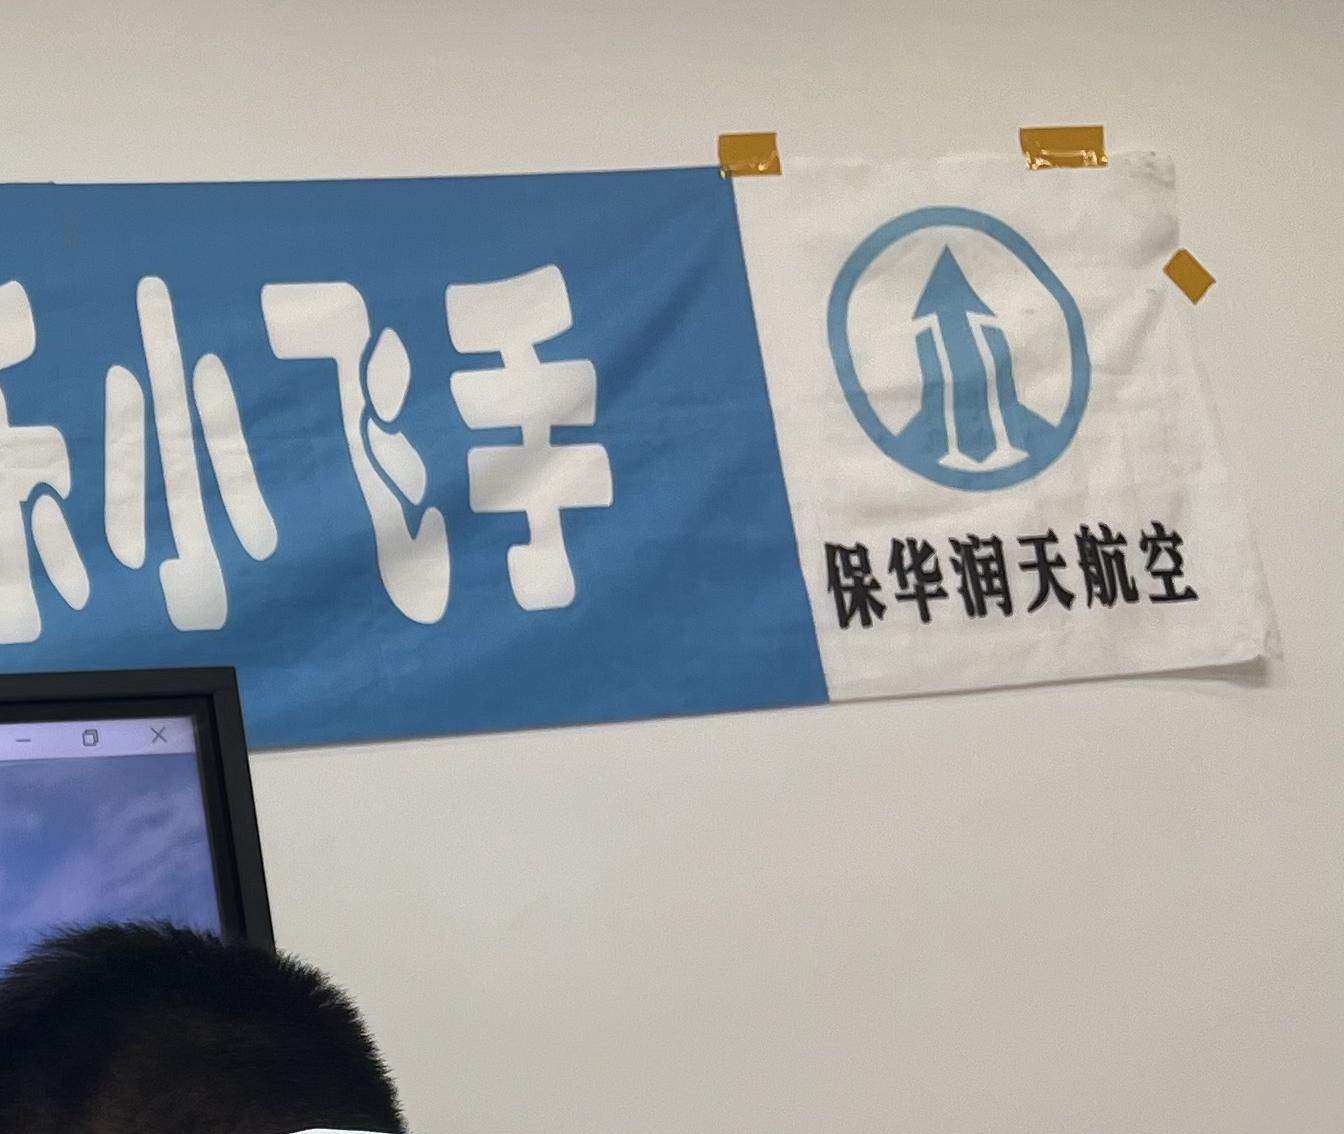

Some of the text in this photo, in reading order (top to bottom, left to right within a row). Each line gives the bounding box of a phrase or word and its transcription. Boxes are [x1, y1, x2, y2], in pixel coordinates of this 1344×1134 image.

[823, 520, 1199, 629] 保华润天航空
